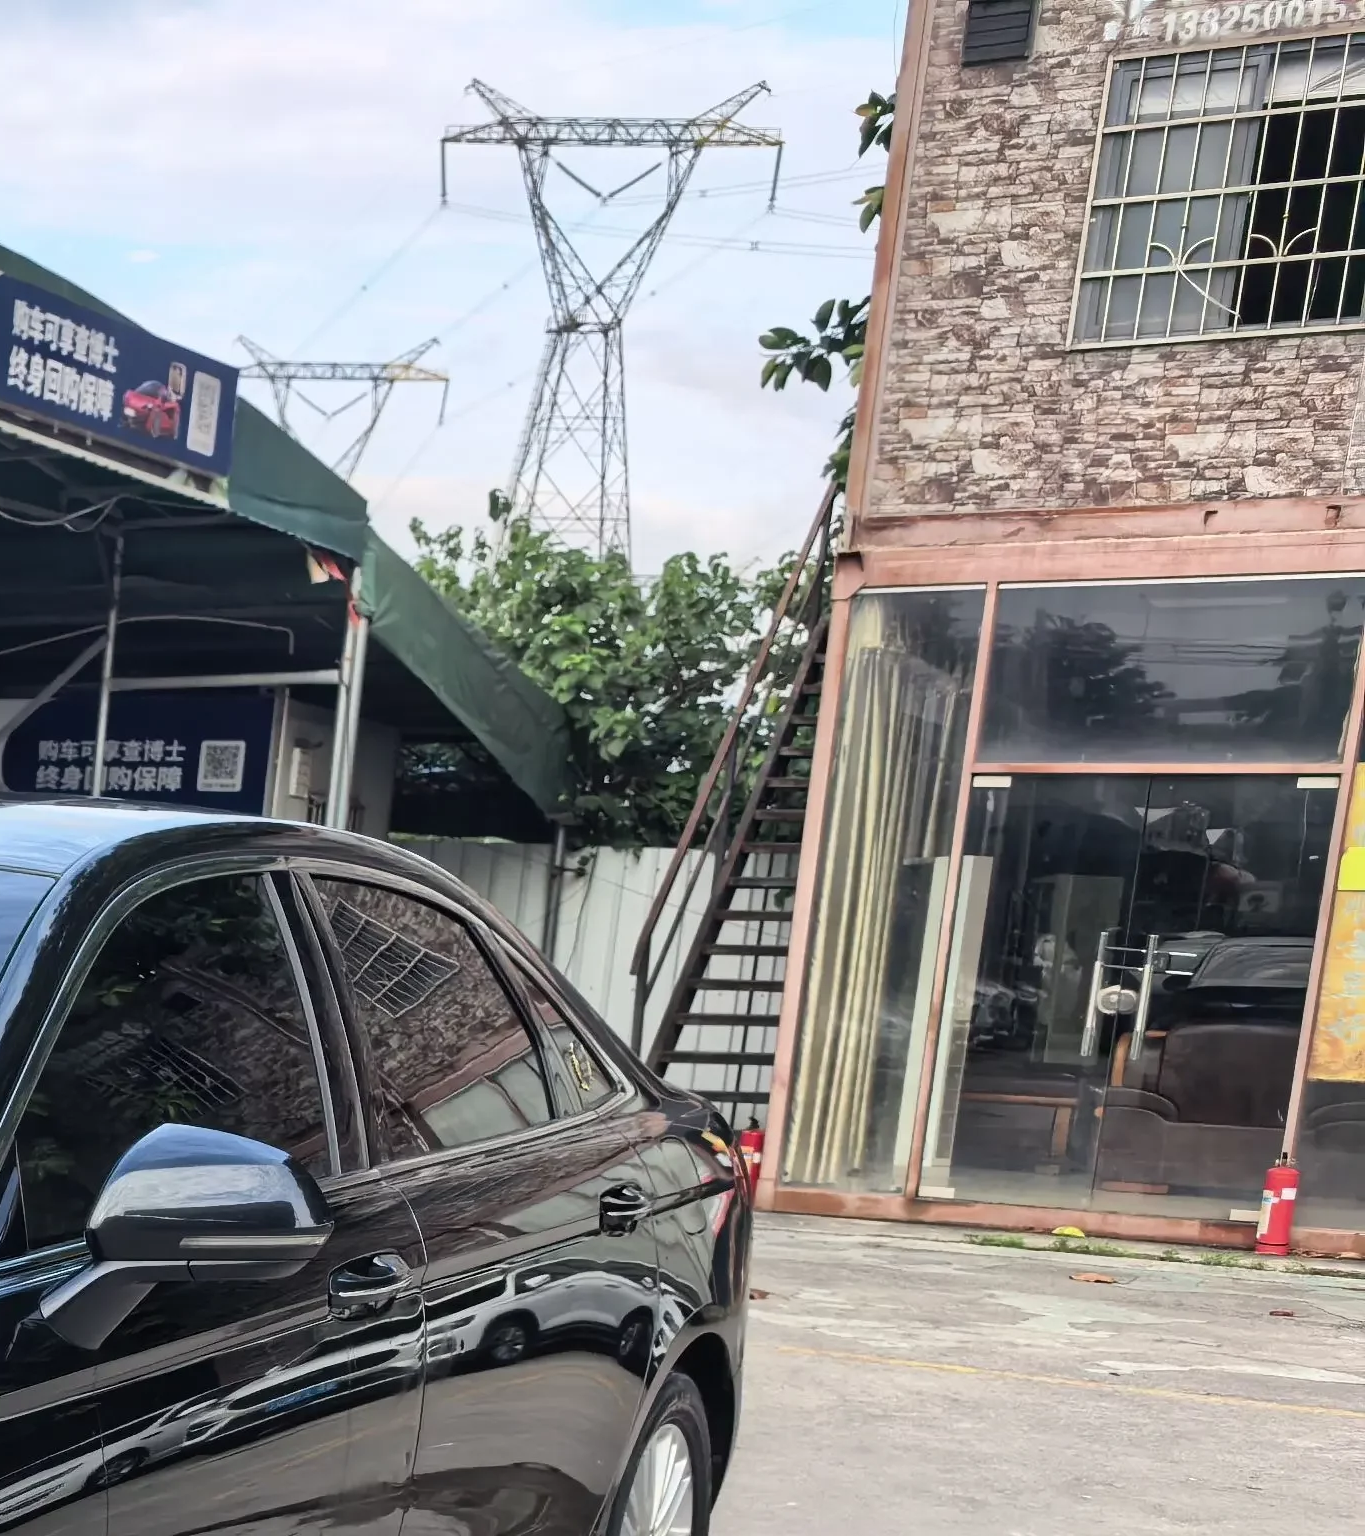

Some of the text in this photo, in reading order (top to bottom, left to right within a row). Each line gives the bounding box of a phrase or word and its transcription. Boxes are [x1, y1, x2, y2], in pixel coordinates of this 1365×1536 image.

[1163, 0, 1365, 46] 138250015
[12, 299, 120, 374] 购车可享查博士
[7, 345, 116, 422] 终身回购保障
